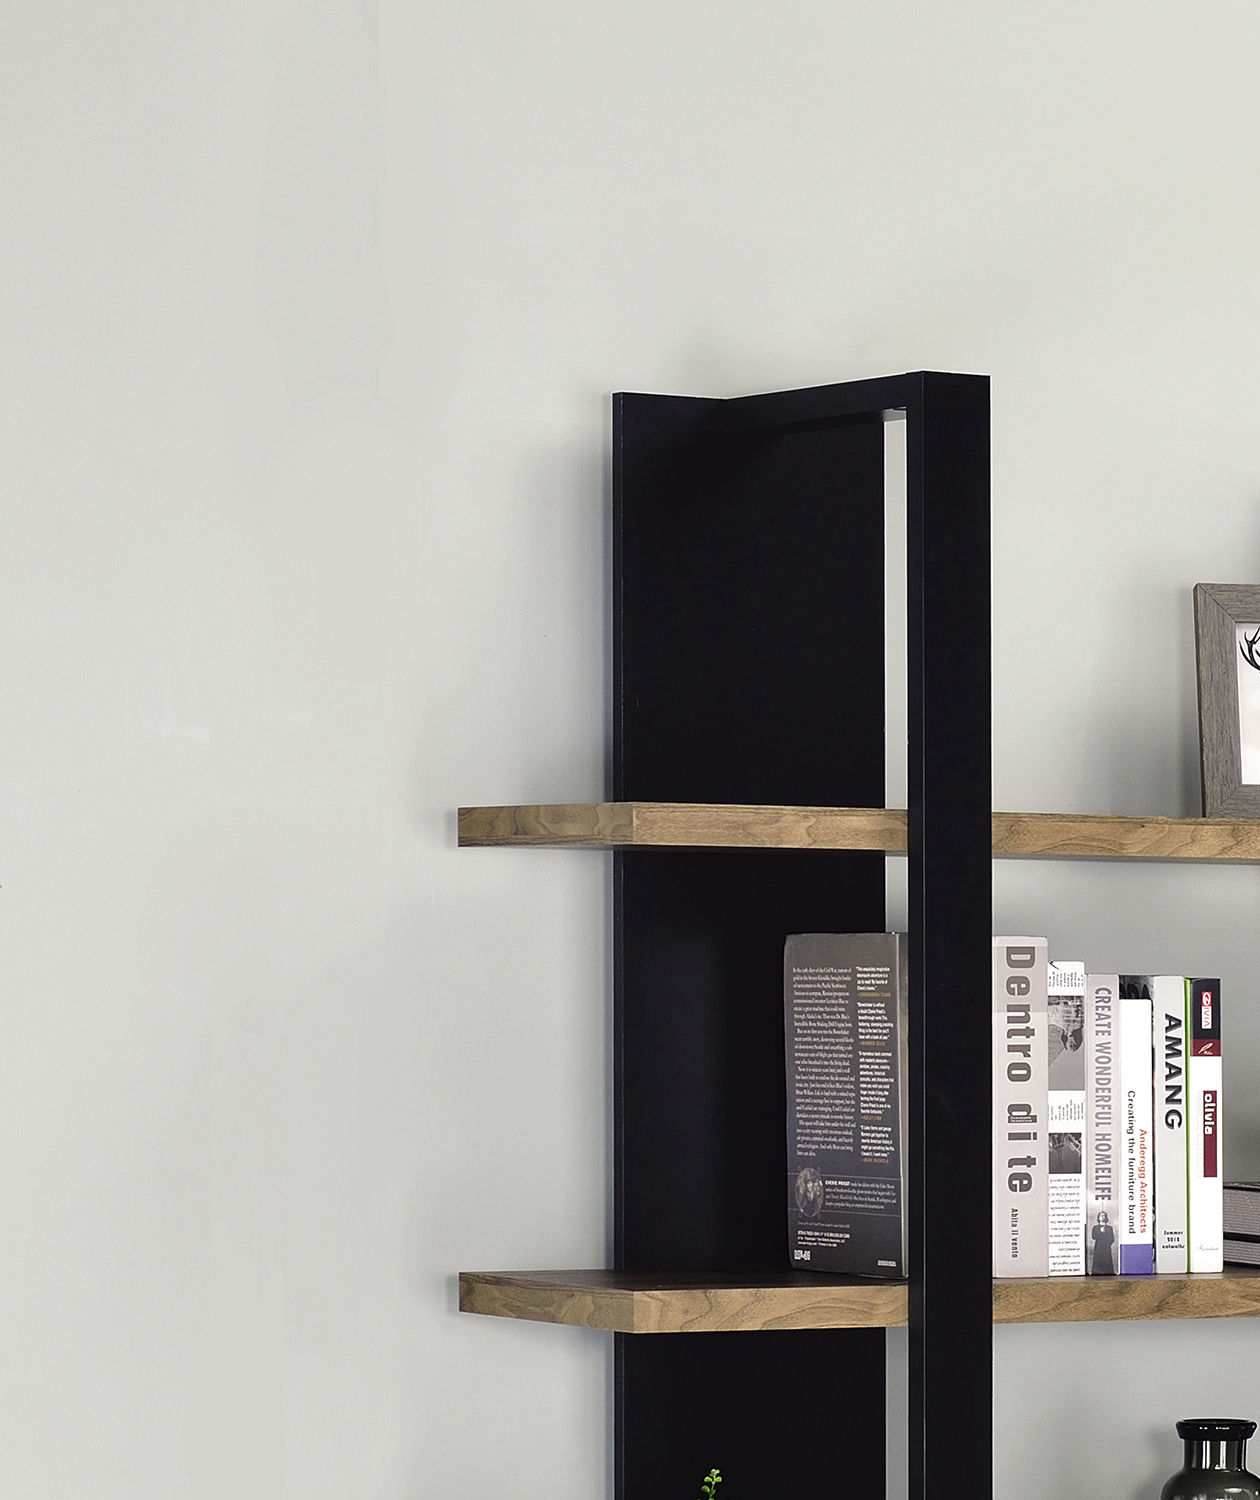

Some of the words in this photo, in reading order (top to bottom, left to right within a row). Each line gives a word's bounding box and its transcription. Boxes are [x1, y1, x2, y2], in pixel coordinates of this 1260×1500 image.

[1006, 946, 1035, 1082] Dentro
[1095, 987, 1112, 1036] CREATE
[1095, 1041, 1112, 1127] WONDERFUL
[1164, 1013, 1183, 1130] AMANG
[1007, 1103, 1037, 1140] di
[1126, 1090, 1136, 1135] Creating
[1204, 1093, 1216, 1135] olivia
[1095, 1133, 1112, 1200] HOMELIFE
[1128, 1138, 1136, 1154] the
[1138, 1128, 1147, 1179] Anderegg
[1007, 1155, 1036, 1192] te
[1128, 1157, 1136, 1201] furniture
[1128, 1204, 1136, 1234] brand
[1139, 1181, 1148, 1233] Architects
